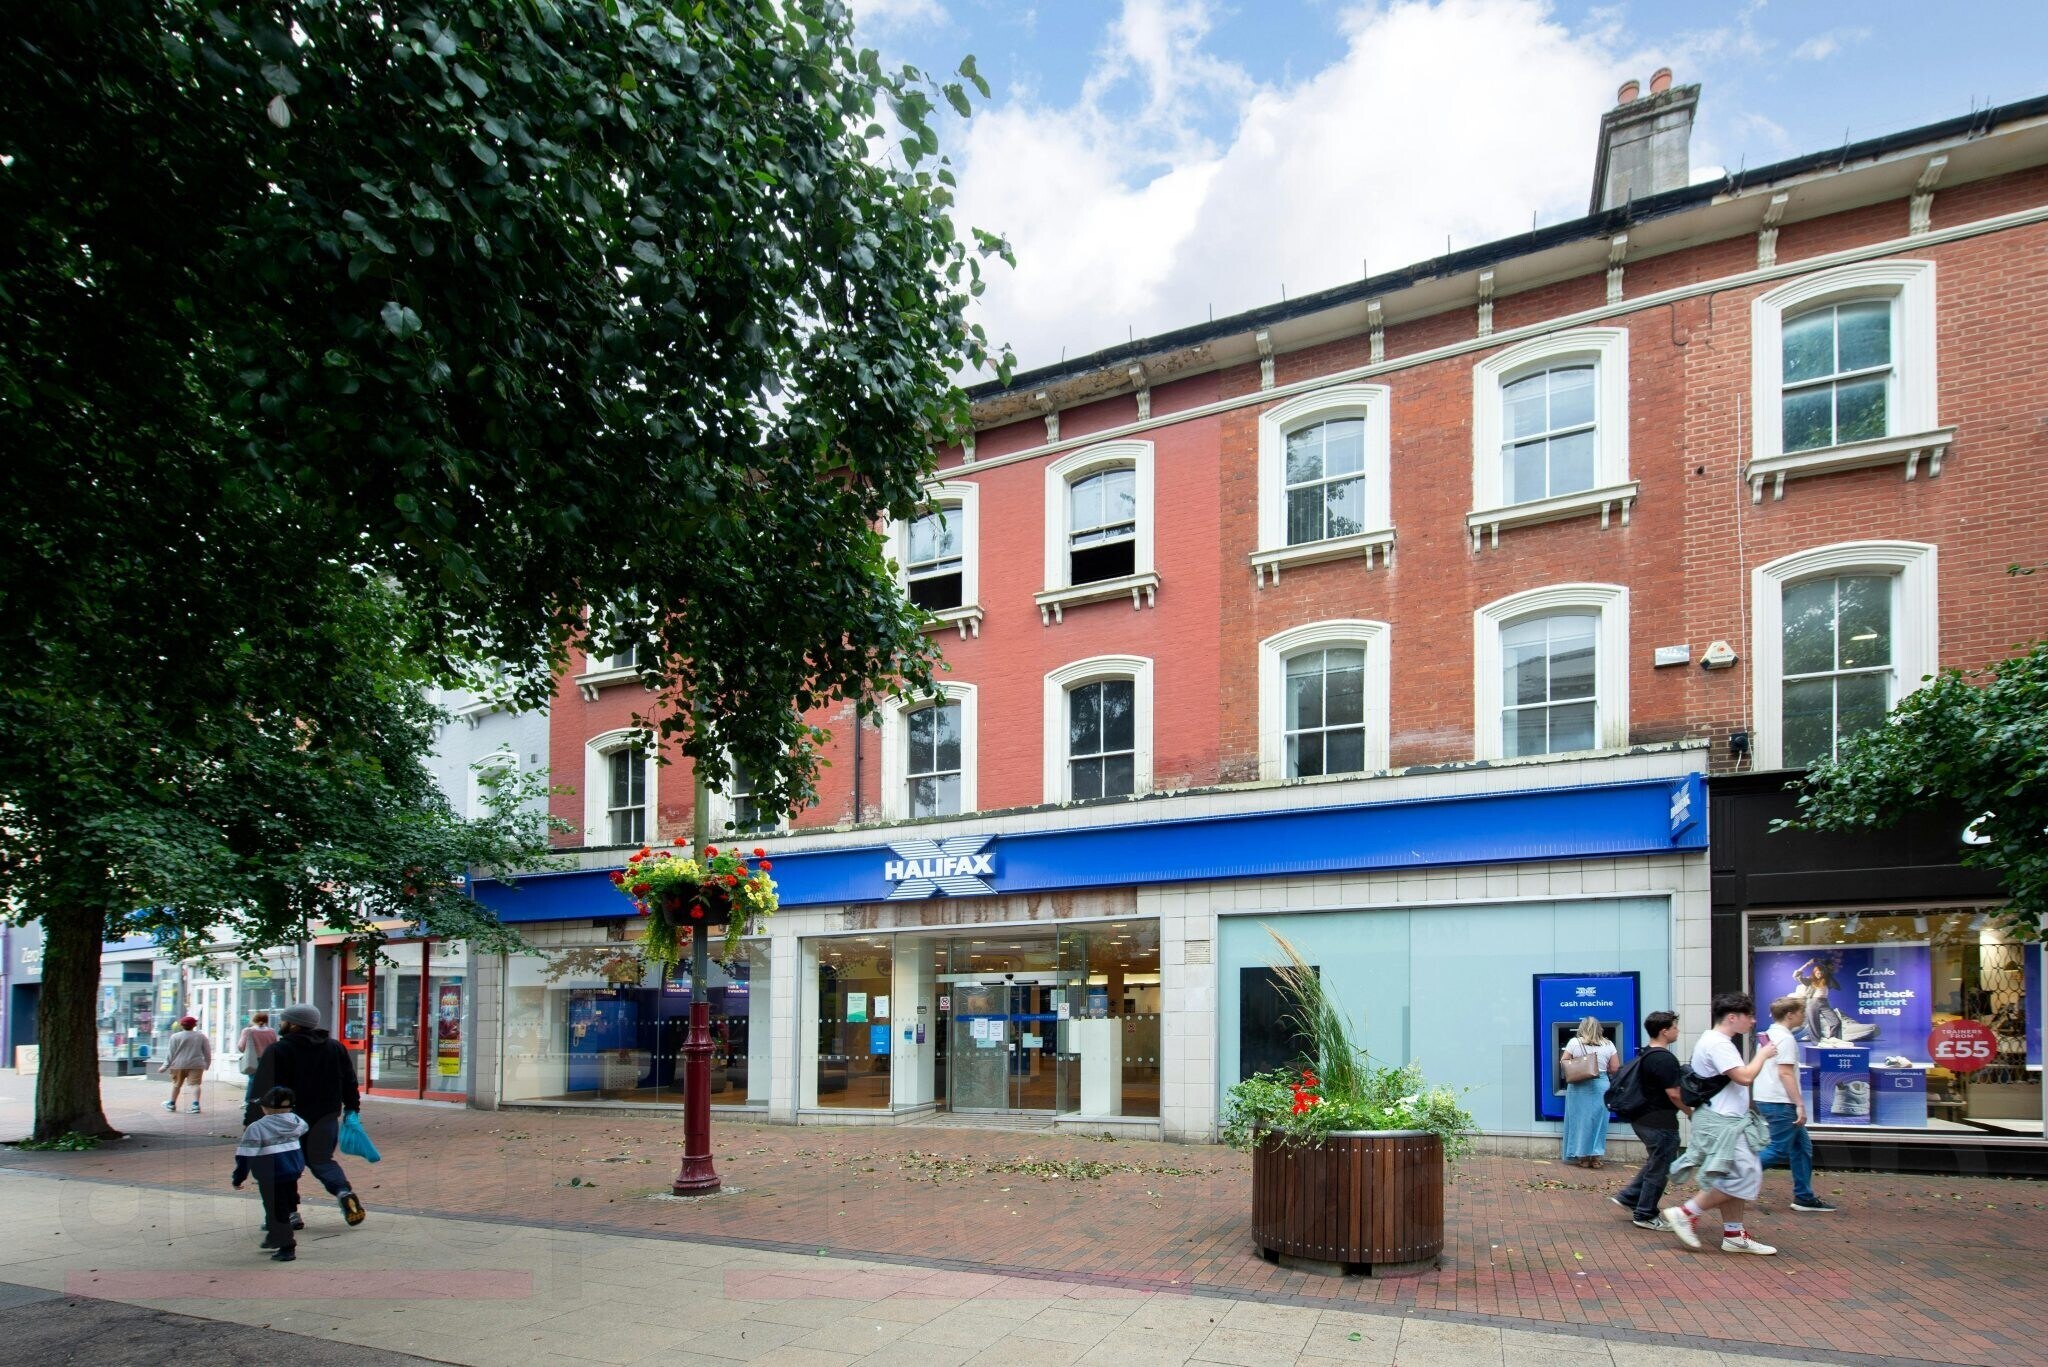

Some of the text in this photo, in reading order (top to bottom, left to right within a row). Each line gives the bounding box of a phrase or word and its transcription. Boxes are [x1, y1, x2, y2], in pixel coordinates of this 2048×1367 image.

[884, 854, 994, 880] HALIFAX
[1857, 968, 1896, 976] Clarks
[1859, 990, 1915, 998] laid-back
[1859, 1007, 1901, 1016] feeling
[1935, 1040, 1990, 1058] £55
